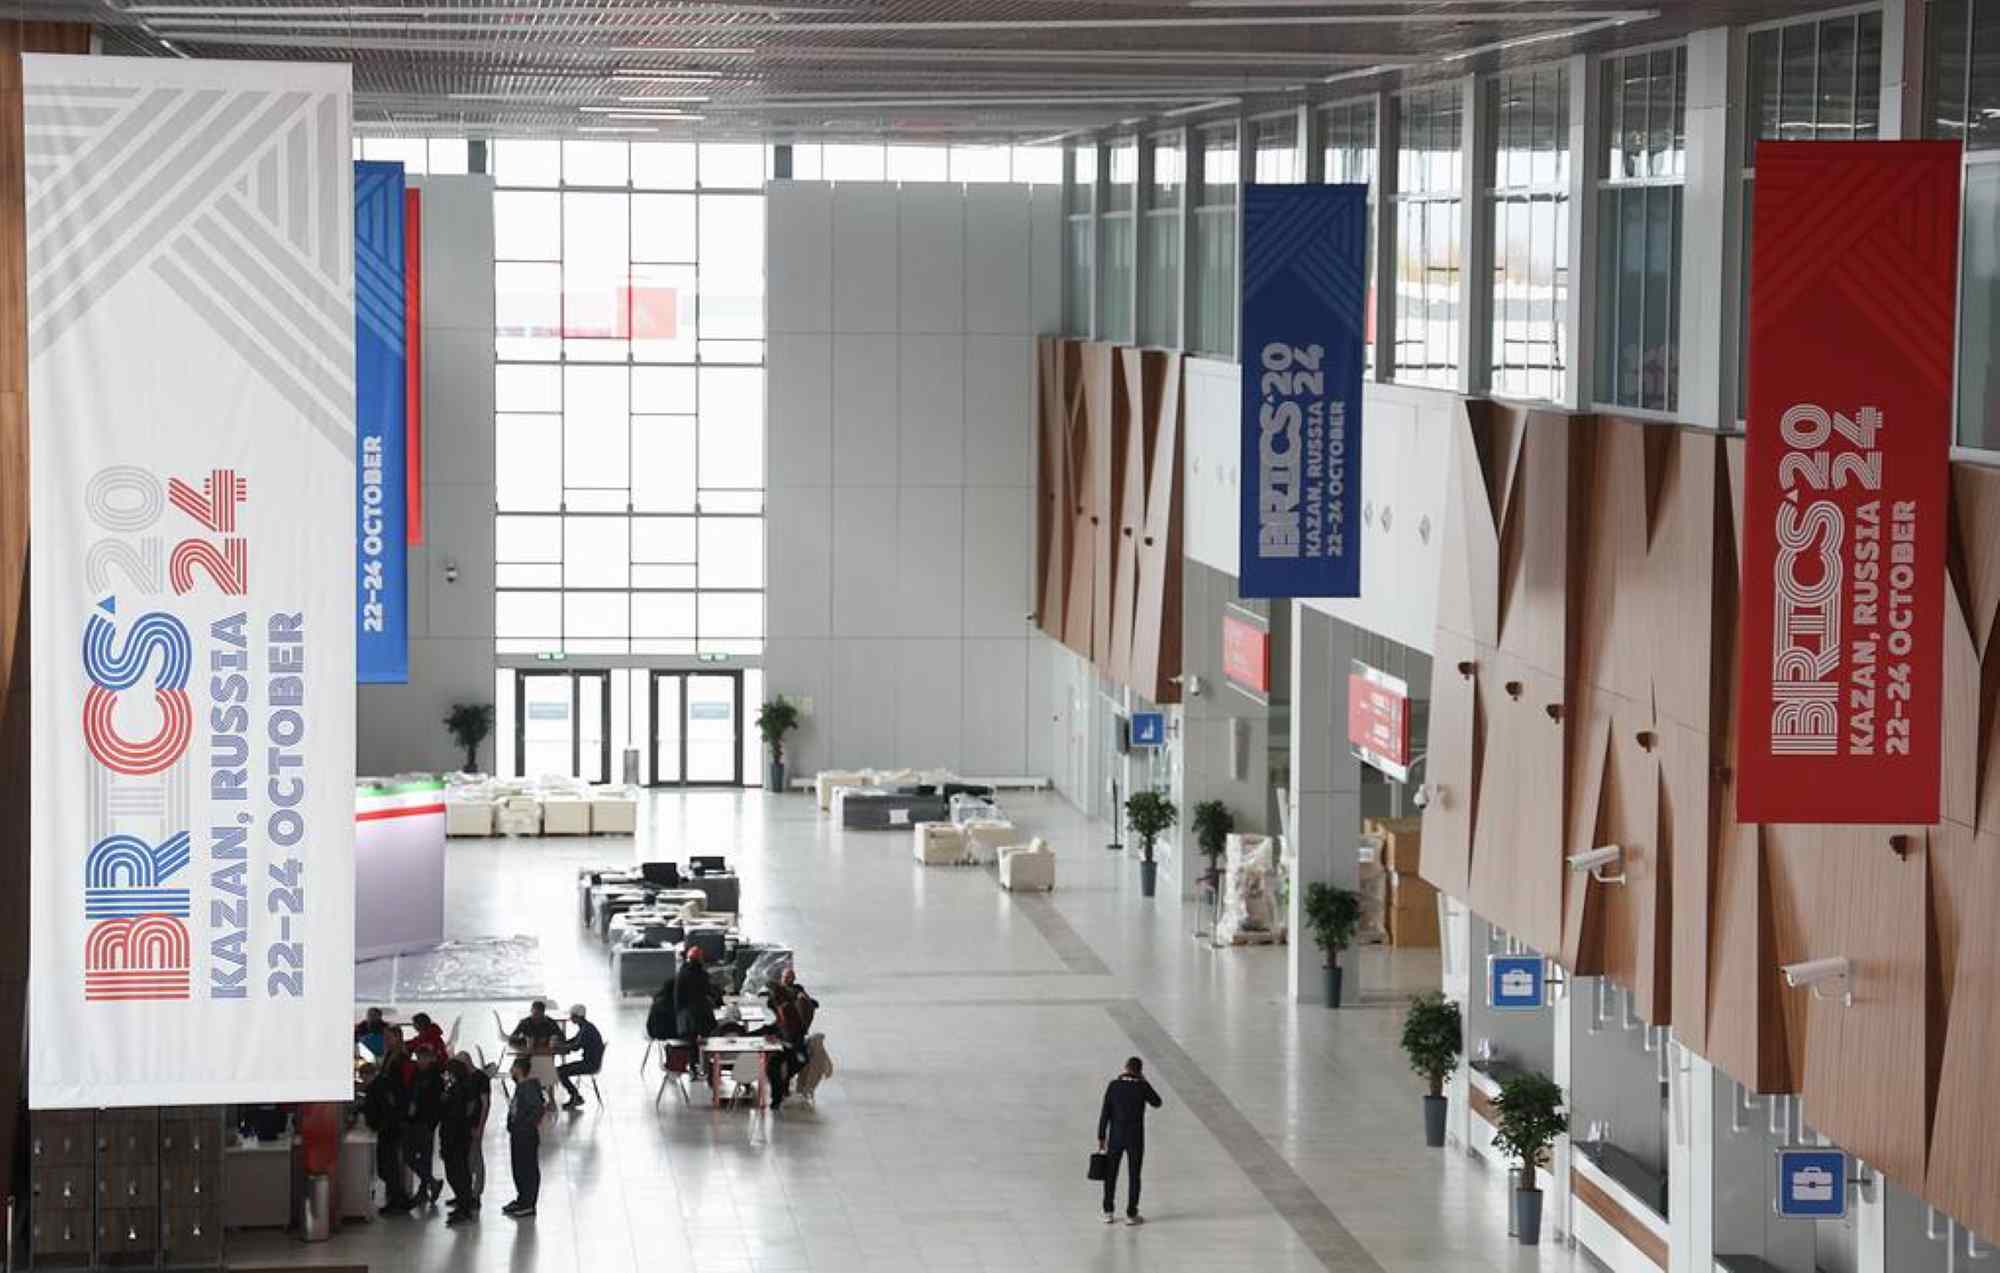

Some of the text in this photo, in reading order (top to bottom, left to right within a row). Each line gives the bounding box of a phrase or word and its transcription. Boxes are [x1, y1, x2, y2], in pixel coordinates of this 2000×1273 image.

[363, 436, 384, 556] OCTOBER
[1306, 402, 1323, 557] KAZAN, RUSSIA
[1329, 402, 1346, 496] OCTOBER
[1850, 500, 1882, 755] KAZAN, RUSSIA
[1888, 501, 1917, 656] OCTOBER
[211, 611, 254, 1000] KAZAN, RUSSIA
[268, 611, 305, 848] OCTOBER
